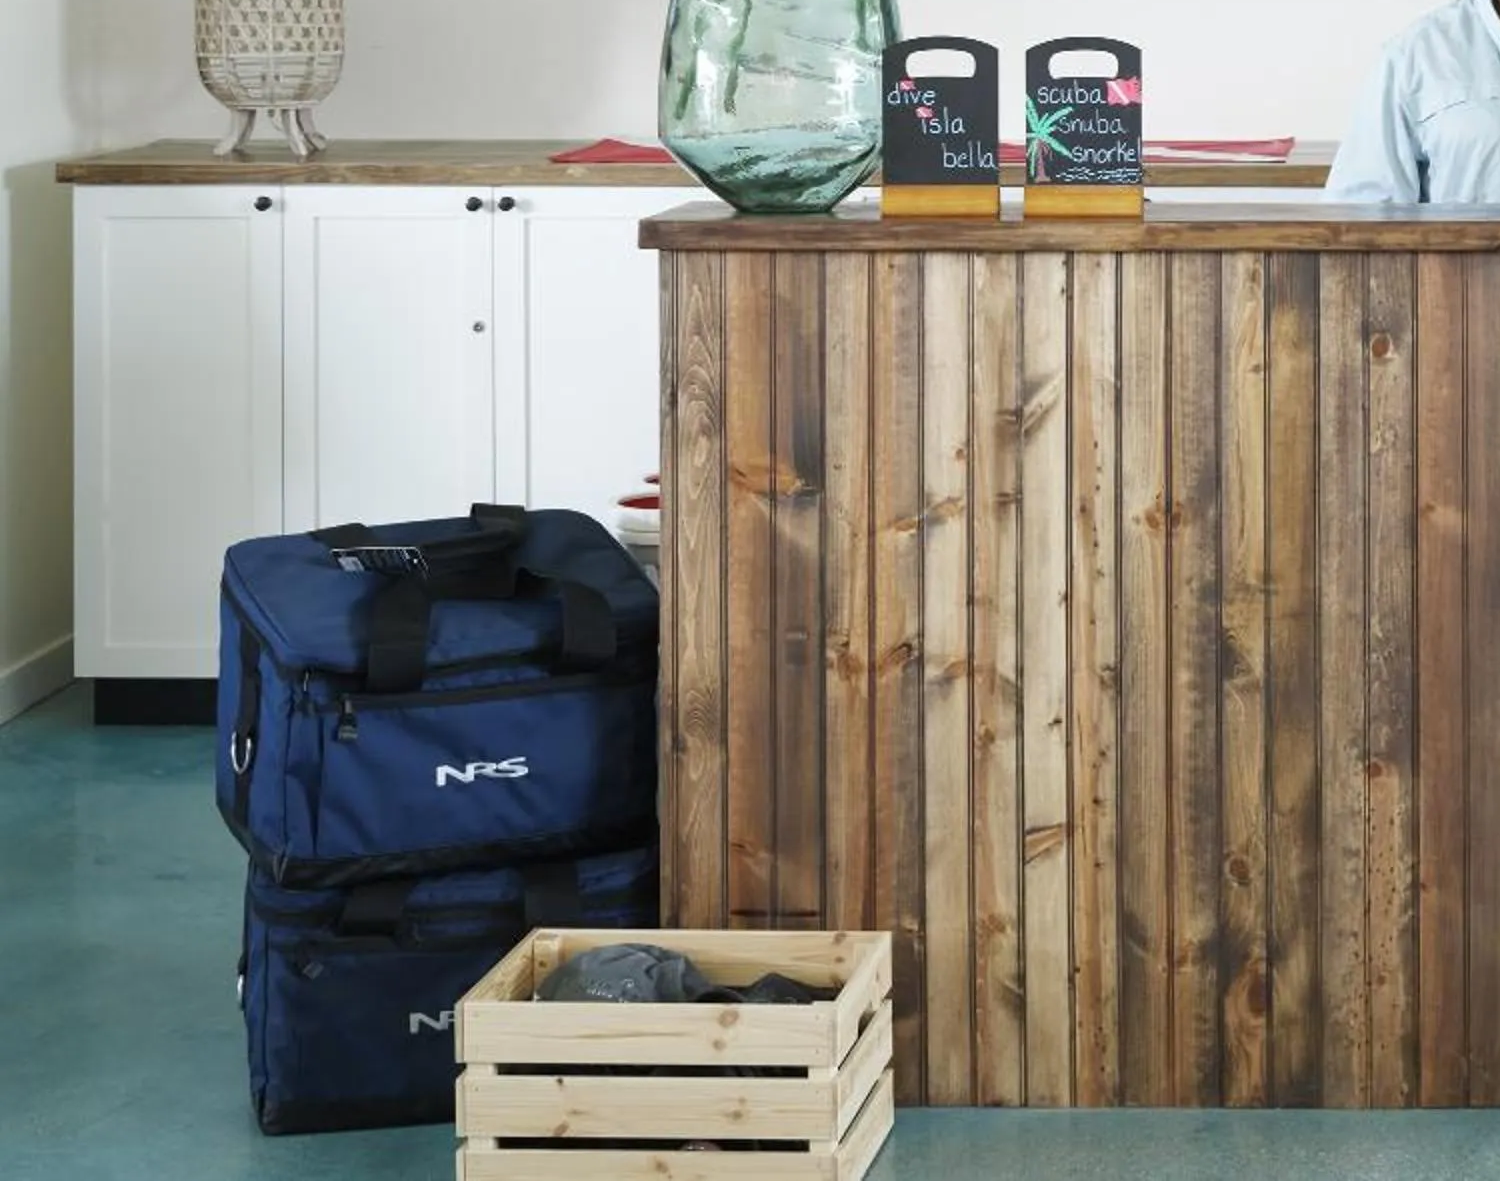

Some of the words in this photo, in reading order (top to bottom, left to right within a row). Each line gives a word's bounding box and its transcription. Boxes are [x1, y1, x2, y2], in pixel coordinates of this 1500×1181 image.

[887, 81, 936, 106] dive
[1037, 78, 1106, 105] scuba
[921, 106, 966, 135] isla
[1057, 109, 1127, 134] snuba
[941, 140, 998, 169] bella
[1071, 135, 1141, 163] snorkel
[435, 756, 529, 787] NRS
